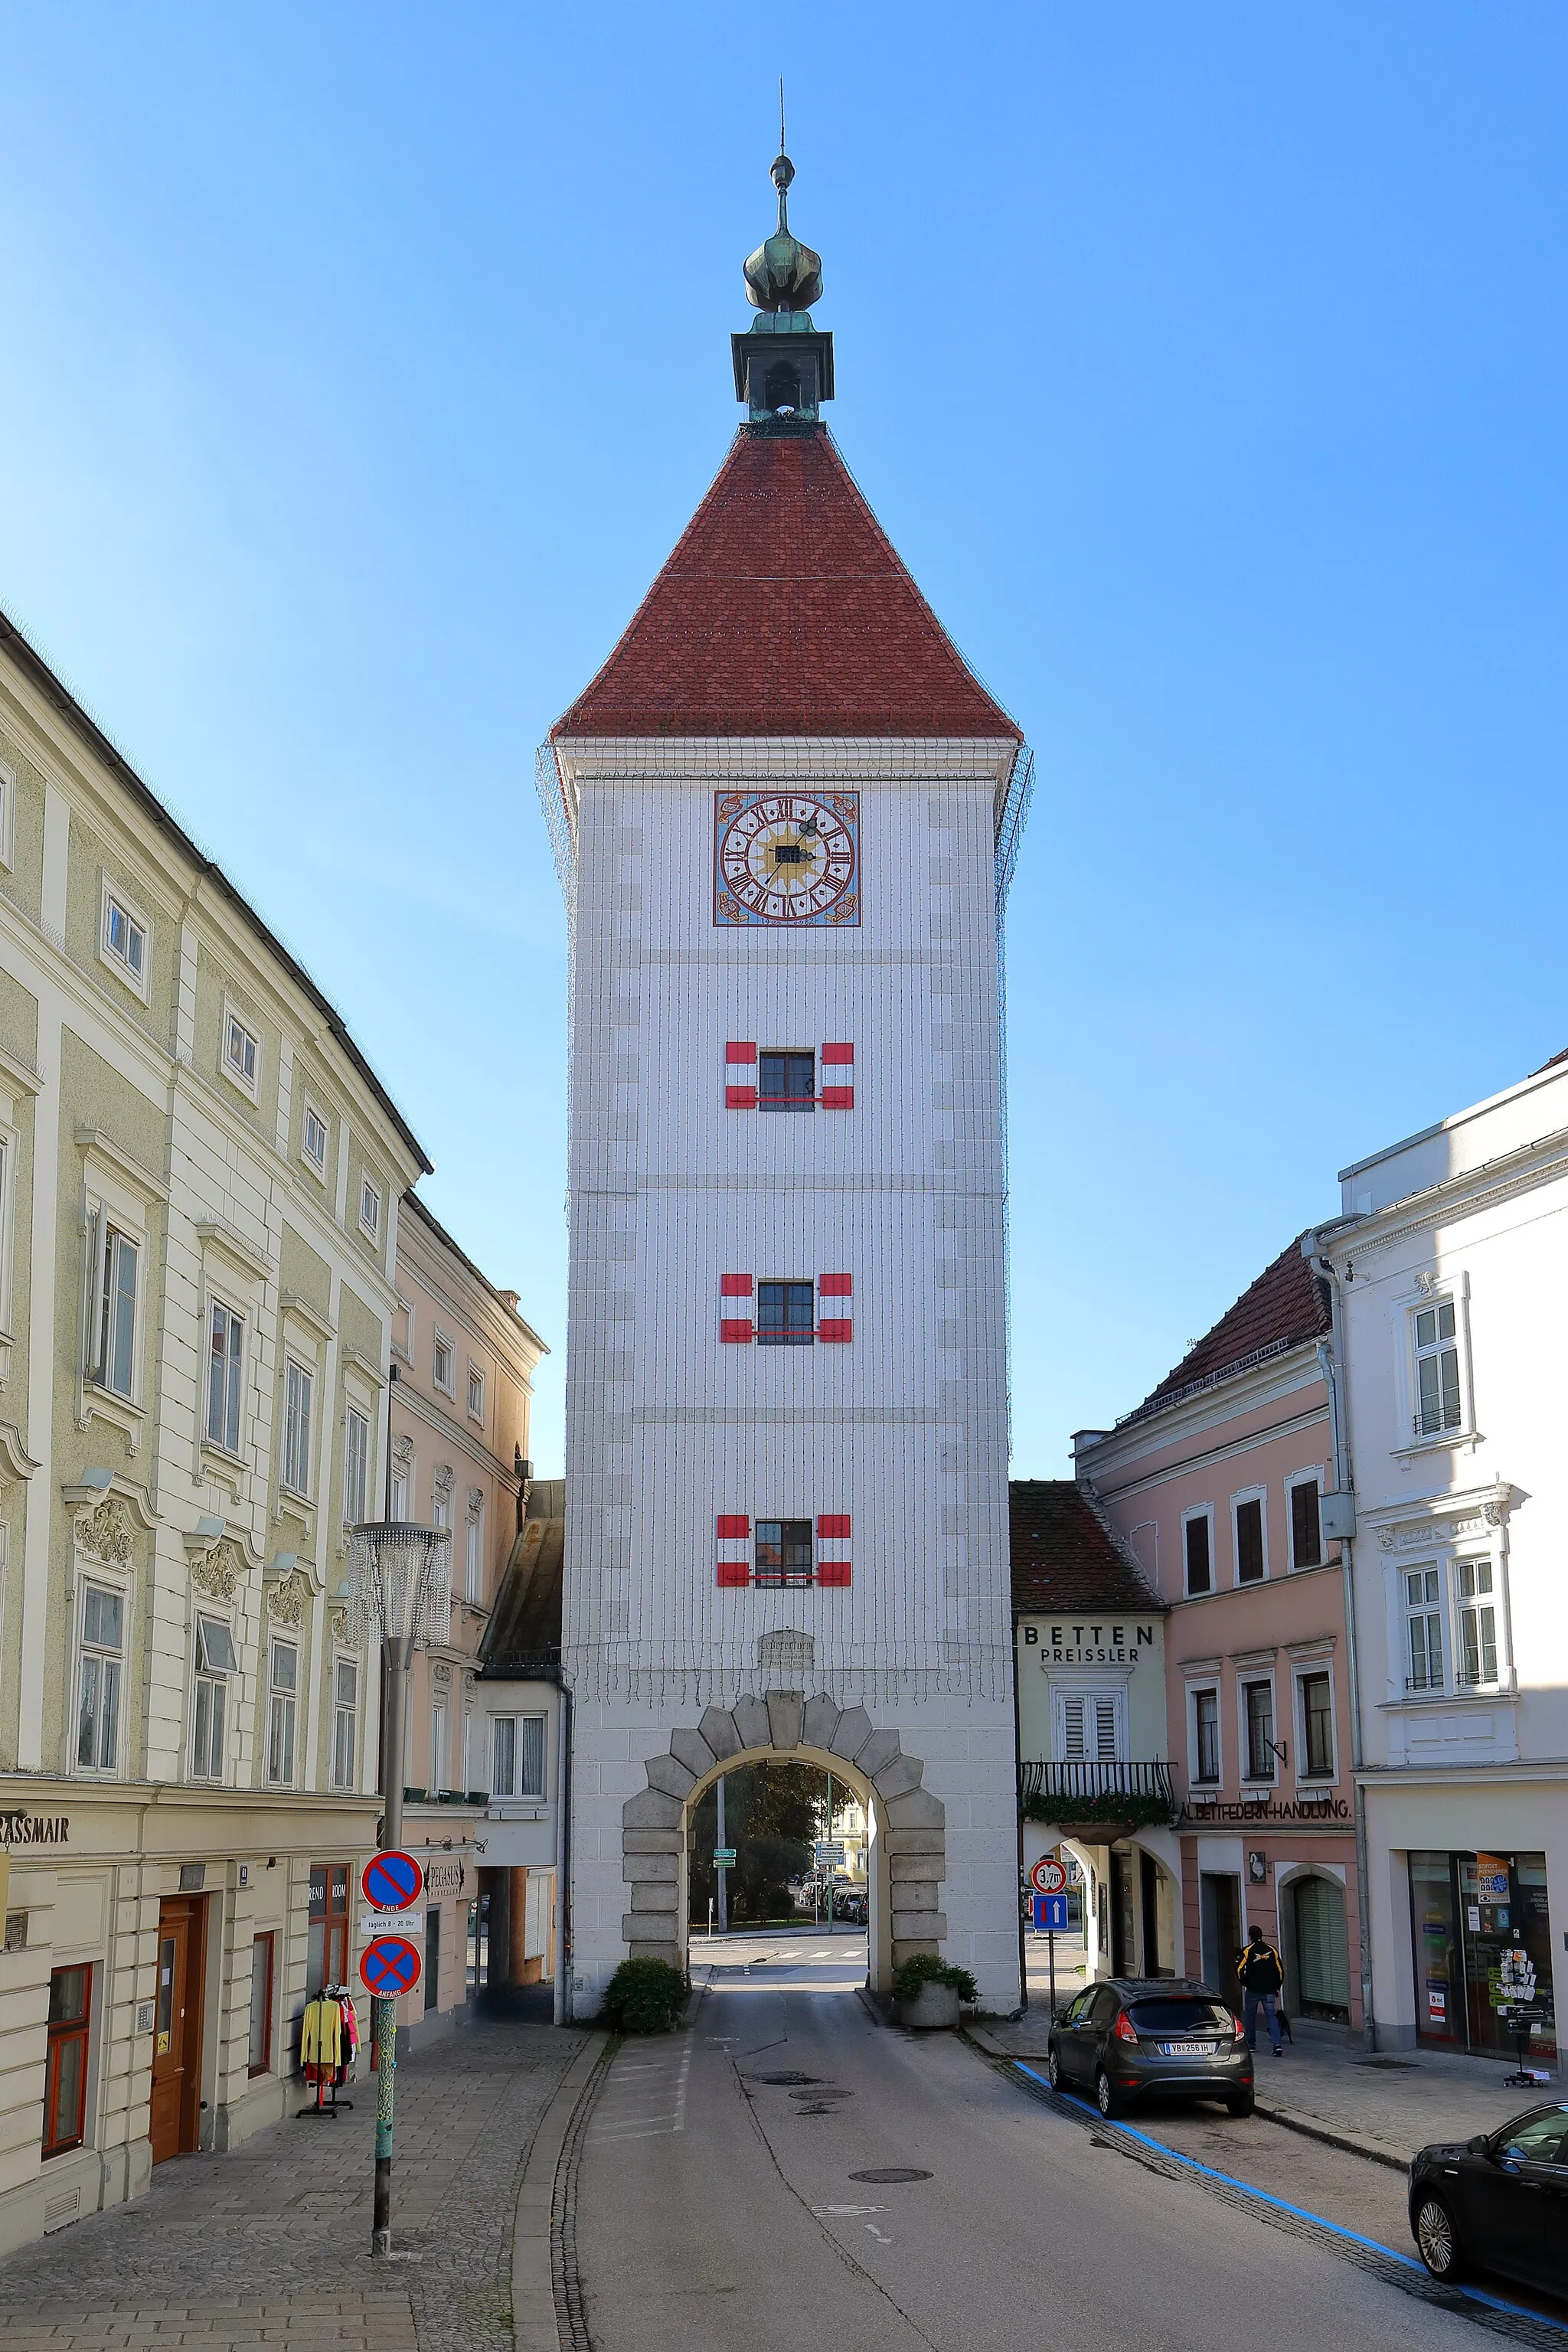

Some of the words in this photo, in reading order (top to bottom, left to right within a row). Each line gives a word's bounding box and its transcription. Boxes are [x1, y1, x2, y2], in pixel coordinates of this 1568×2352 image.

[777, 799, 793, 818] XII
[1024, 1626, 1153, 1645] BETTEN
[1041, 1648, 1139, 1662] PREISSLER
[430, 1865, 459, 1888] PEGASUS
[332, 1883, 346, 1898] ROOM
